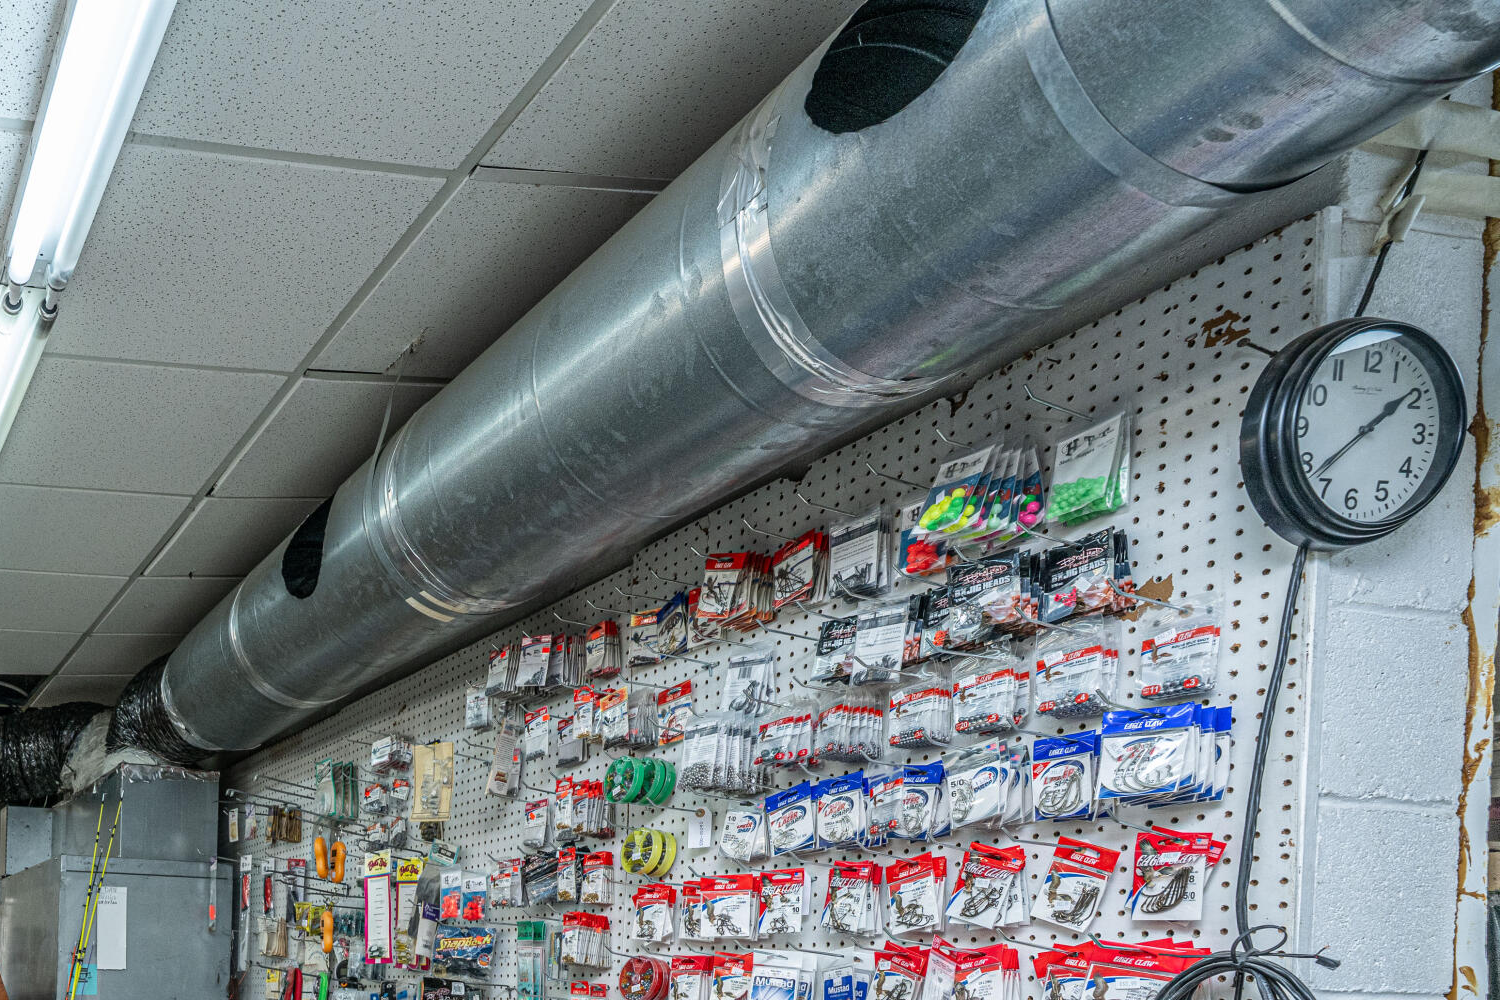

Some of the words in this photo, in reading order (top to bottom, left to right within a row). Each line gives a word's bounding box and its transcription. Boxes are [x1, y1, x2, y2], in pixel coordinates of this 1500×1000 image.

[1333, 359, 1344, 381] 11
[1364, 351, 1382, 373] 12
[1393, 361, 1399, 383] 1
[1307, 384, 1328, 406] 10
[1408, 387, 1422, 409] 2
[1297, 416, 1309, 438] 9
[1412, 423, 1426, 444] 3
[1300, 451, 1313, 474] 8
[1399, 456, 1413, 478] 4
[1319, 478, 1332, 499] 7
[1344, 488, 1358, 509] 6
[1375, 480, 1388, 501] 5
[1078, 558, 1106, 573] HEADS
[983, 576, 1011, 589] HEADS
[1045, 701, 1054, 710] 15
[1124, 721, 1143, 730] EAGLE
[1145, 719, 1165, 729] CLAW
[1113, 956, 1132, 965] EAGLE
[1135, 958, 1155, 967] CLAW
[828, 985, 849, 994] Mustad
